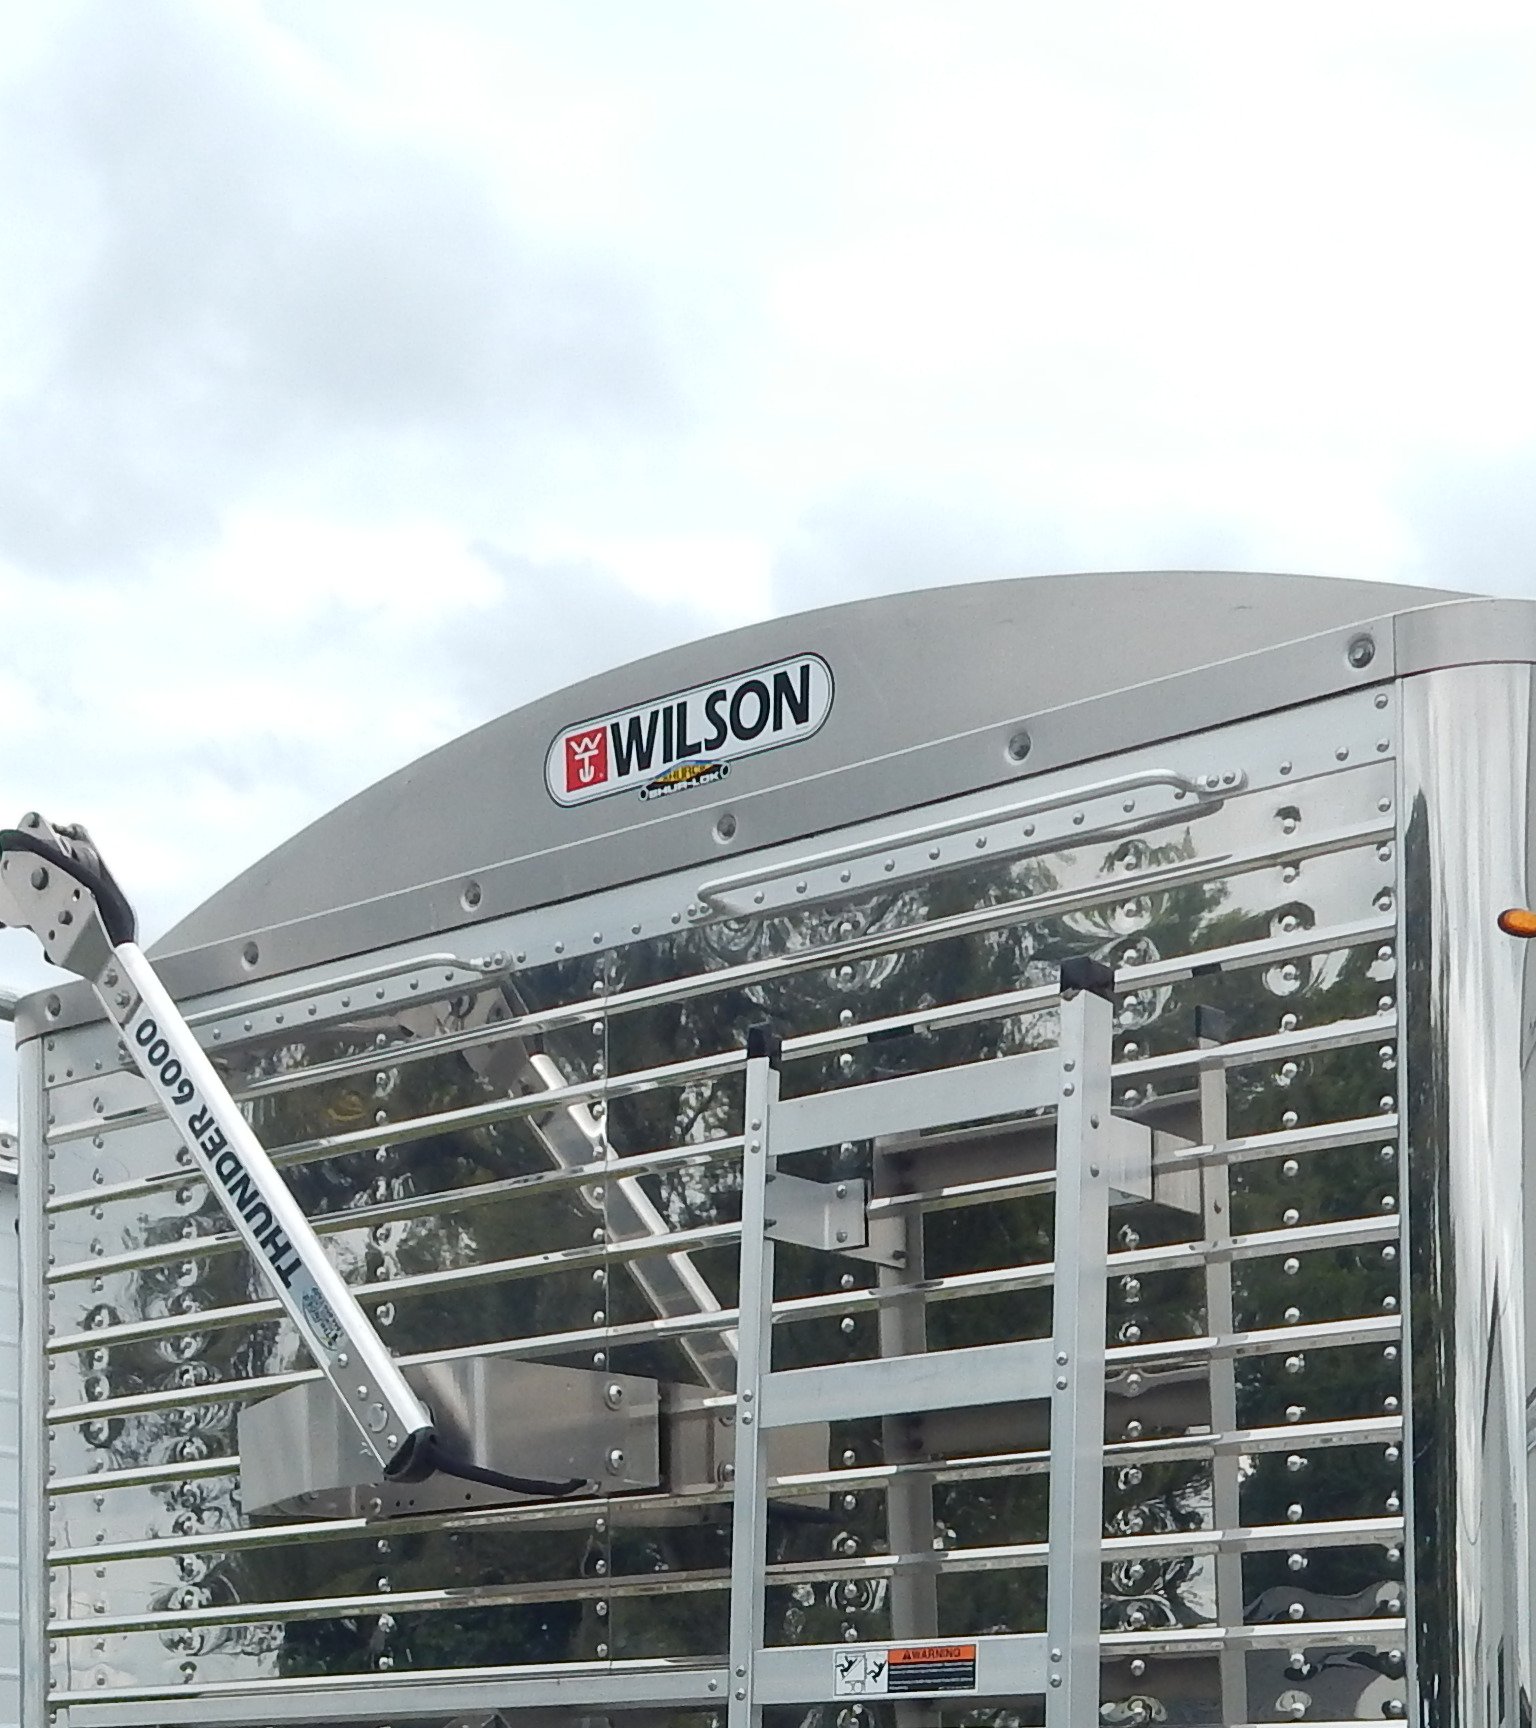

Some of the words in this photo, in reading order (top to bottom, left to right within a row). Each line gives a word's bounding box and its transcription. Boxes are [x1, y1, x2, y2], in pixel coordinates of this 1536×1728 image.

[611, 664, 810, 777] WILSON
[135, 1019, 194, 1105] 6000
[188, 1104, 302, 1289] THUNDER
[912, 1648, 961, 1659] WARNING
